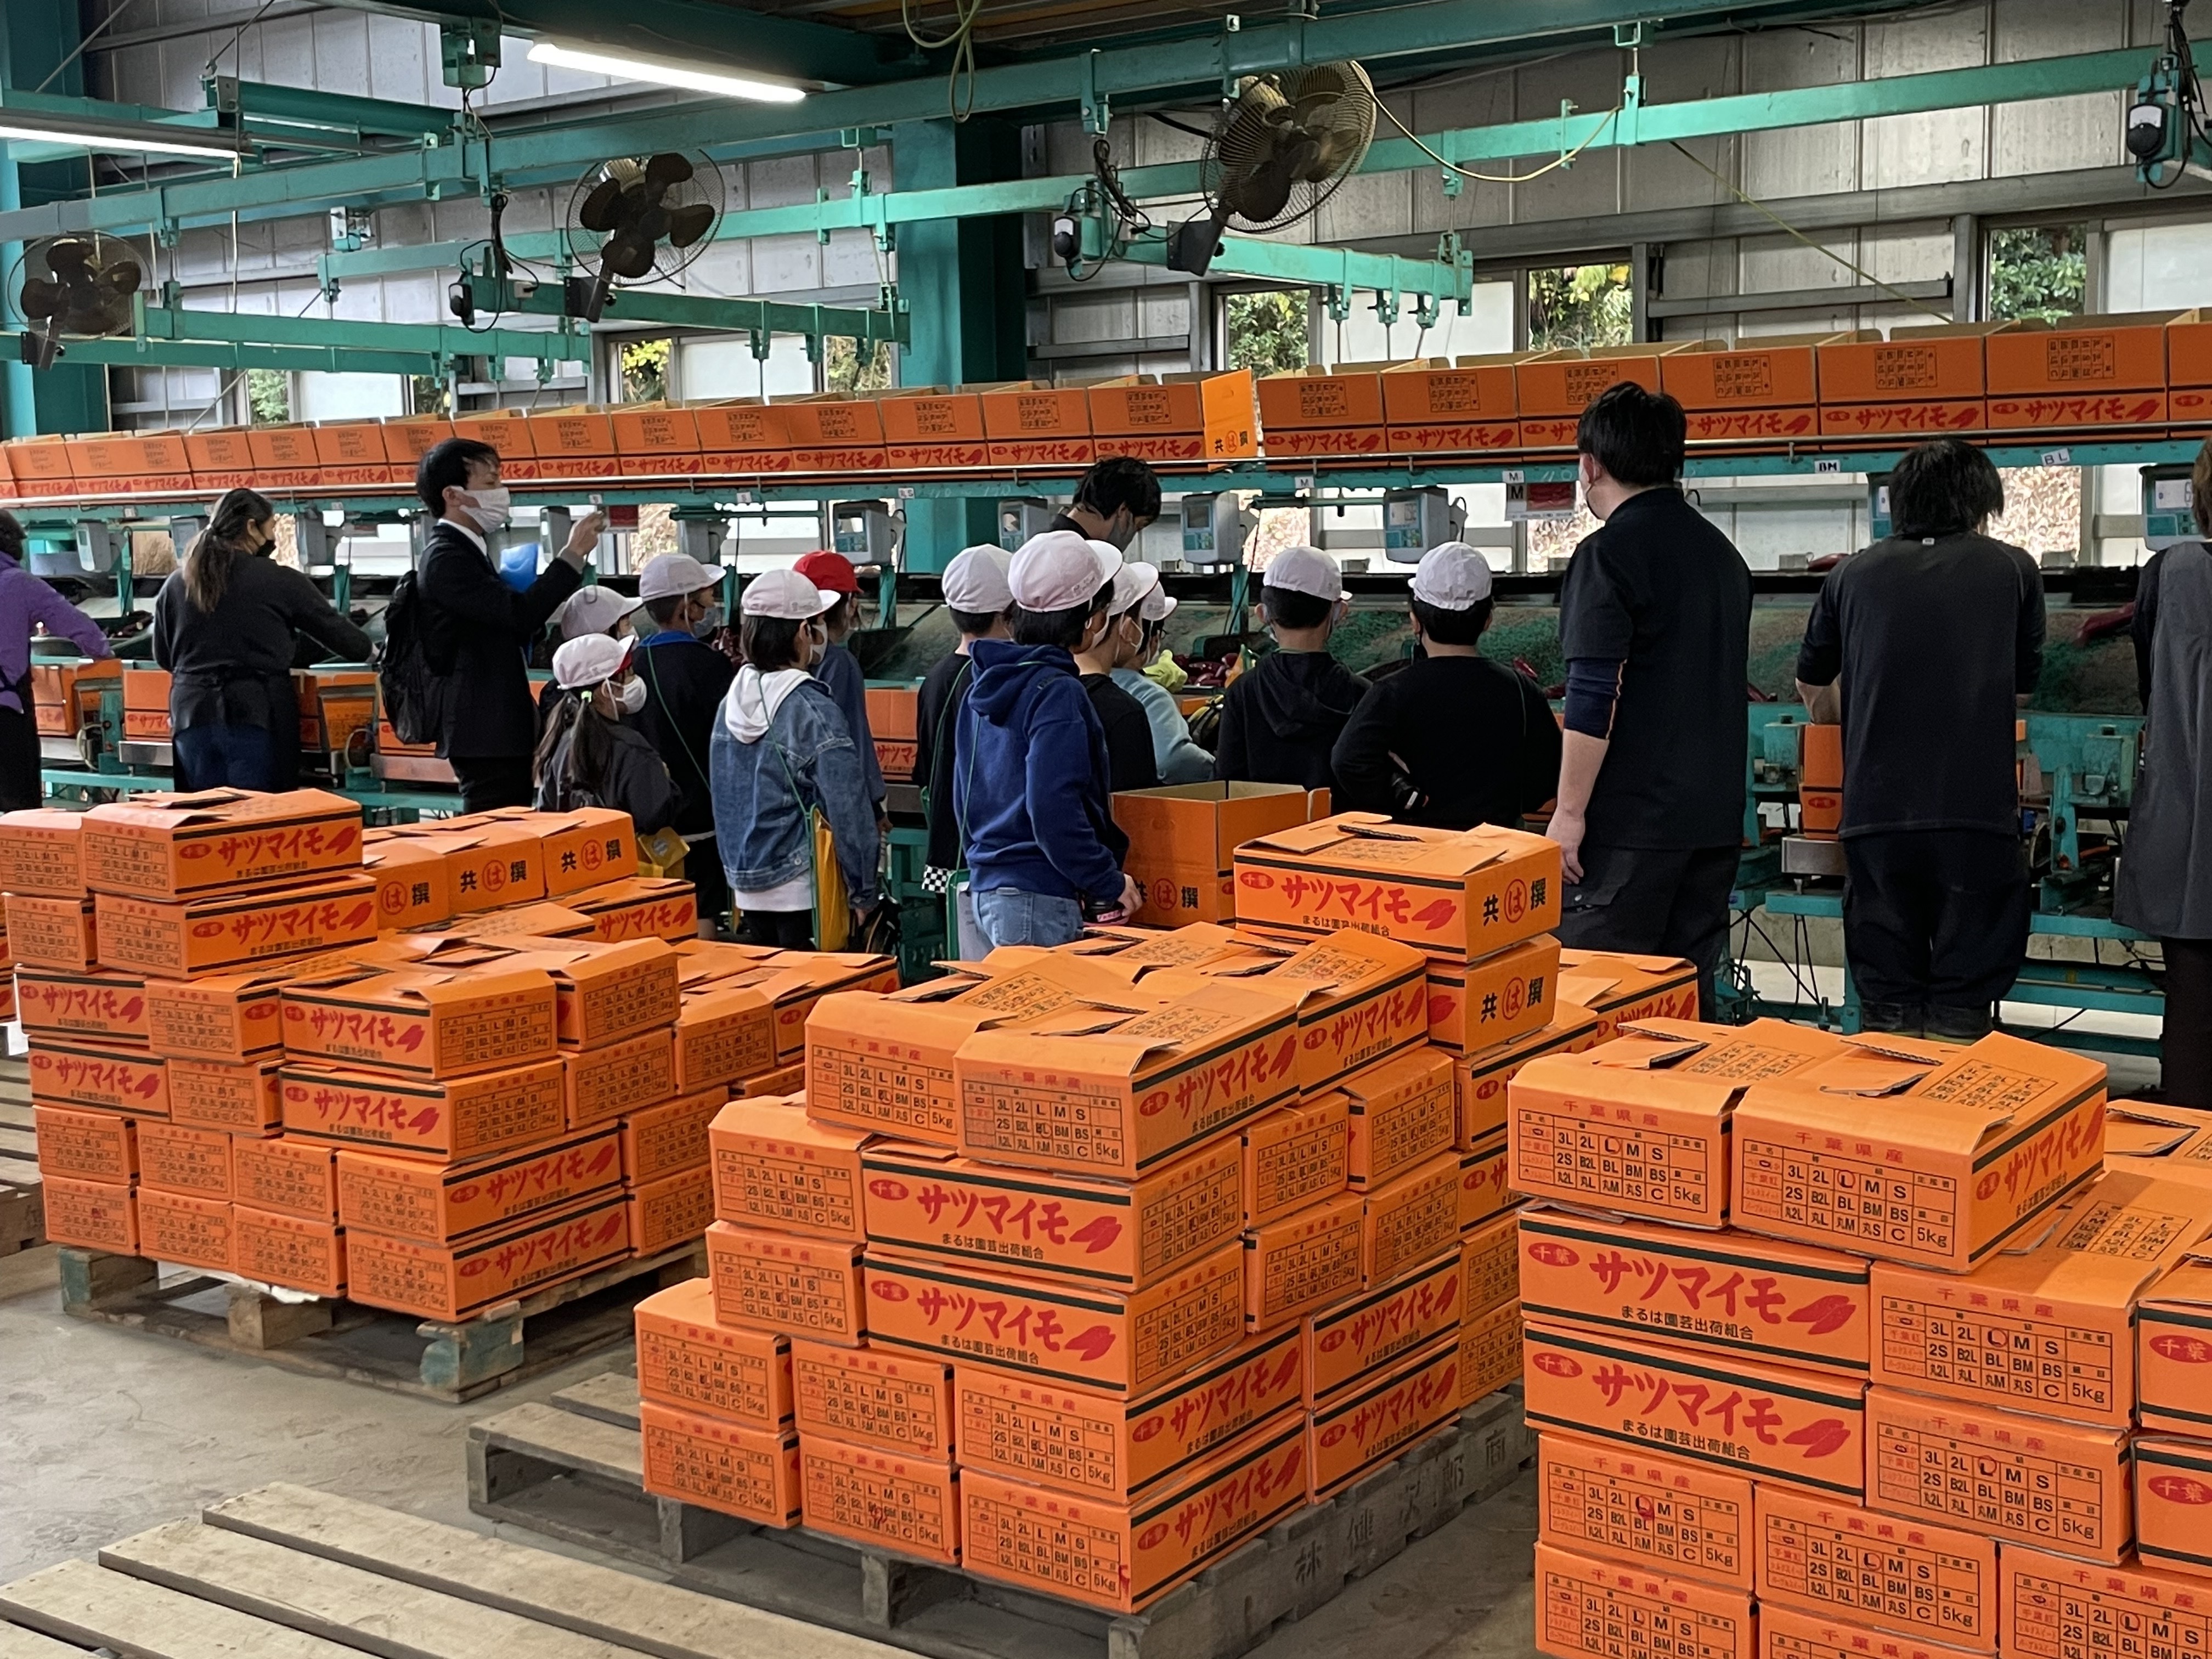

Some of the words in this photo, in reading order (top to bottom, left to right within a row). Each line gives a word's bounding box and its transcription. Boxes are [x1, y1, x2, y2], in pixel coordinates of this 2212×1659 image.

[1698, 413, 1782, 435] サツマイモ
[1855, 405, 1949, 430] サツマイモ
[2025, 398, 2125, 422] サツマイモ
[1011, 444, 1069, 462] サツマイモ
[1119, 441, 1181, 459] サツマイモ
[1288, 433, 1357, 453] サツマイモ
[1417, 428, 1490, 447] サツマイモ
[557, 461, 601, 476] サツマイモ
[639, 458, 684, 473] サツマイモ
[724, 455, 773, 472] サツマイモ
[814, 450, 866, 468] サツマイモ
[909, 448, 965, 465] サツマイモ
[1819, 462, 1837, 471] BM
[2044, 453, 2067, 465] BL
[1300, 478, 1308, 486] M
[1510, 472, 1518, 481] M
[1511, 486, 1523, 499] M
[139, 715, 170, 728] サツマ
[878, 744, 916, 763] サツマ
[218, 827, 325, 866] サツマイモ
[381, 881, 430, 914] は撰
[1282, 875, 1410, 924] サツマイモ
[232, 901, 340, 943] サツマイモ
[600, 905, 671, 938] サツマイモ
[43, 986, 117, 1018] サツマイモ
[311, 1008, 396, 1044] サツマイモ
[1332, 989, 1404, 1054] サツマイモ
[57, 1058, 133, 1093] サツマイモ
[1175, 1043, 1267, 1119] サツマイモ
[314, 1090, 407, 1129] サツマイモ
[1564, 1101, 1658, 1126] 千葉県産
[1558, 1132, 1573, 1146] 3L
[1580, 1136, 1595, 1149] 2L
[1605, 1139, 1617, 1152] L
[1627, 1143, 1639, 1155] M
[1652, 1148, 1663, 1160] S
[1796, 1132, 1904, 1163] 千葉県産
[2005, 1111, 2081, 1204] サツマイモ
[487, 1152, 584, 1203] サツマイモ
[1557, 1152, 1572, 1165] 2S
[1580, 1156, 1596, 1169] B2L
[1603, 1160, 1618, 1173] BL
[1626, 1165, 1643, 1178] BM
[1650, 1168, 1666, 1181] BS
[1788, 1165, 1804, 1179] 3L
[1813, 1170, 1830, 1184] 2L
[1841, 1175, 1853, 1187] L
[1866, 1180, 1880, 1193] M
[1894, 1186, 1906, 1198] S
[1651, 1188, 1663, 1200] C
[1674, 1186, 1701, 1205] 5kg
[1785, 1187, 1803, 1200] 2S
[1812, 1191, 1830, 1205] B2L
[1838, 1197, 1854, 1210] BL
[1864, 1201, 1882, 1217] BM
[1891, 1207, 1908, 1222] BS
[917, 1184, 1069, 1245] サツマイモ
[496, 1218, 591, 1278] サツマイモ
[1891, 1228, 1905, 1241] C
[1917, 1227, 1946, 1247] 5kg
[1590, 1250, 1785, 1323] サツマイモ
[1351, 1283, 1433, 1355] サツマイモ
[1938, 1289, 2054, 1317] 千葉県産
[917, 1287, 1063, 1352] サツマイモ
[1622, 1306, 1754, 1340] まるは園芸出荷組合
[1931, 1323, 1949, 1337] 3L
[1957, 1328, 1976, 1341] 2L
[1989, 1331, 2002, 1346] L
[2015, 1336, 2030, 1350] M
[2045, 1341, 2058, 1355] S
[1929, 1344, 1948, 1357] 2S
[1957, 1348, 1977, 1362] B2L
[1985, 1354, 2004, 1367] BL
[2013, 1359, 2033, 1373] BM
[2042, 1363, 2062, 1378] BS
[1171, 1358, 1269, 1442] サツマイモ
[1592, 1364, 1782, 1445] サツマイモ
[2045, 1384, 2059, 1398] C
[2072, 1383, 2104, 1403] 5kg
[1351, 1373, 1432, 1448] サツマイモ
[1623, 1419, 1750, 1460] まるは園芸出荷組合
[1931, 1417, 2046, 1451] 千葉県産
[1594, 1457, 1690, 1489] 千葉県産
[1176, 1459, 1273, 1547] サツマイモ
[1818, 1512, 1926, 1545] 千葉県産
[1592, 1570, 1688, 1604] 千葉県産
[2073, 1571, 2193, 1609] 千葉県産
